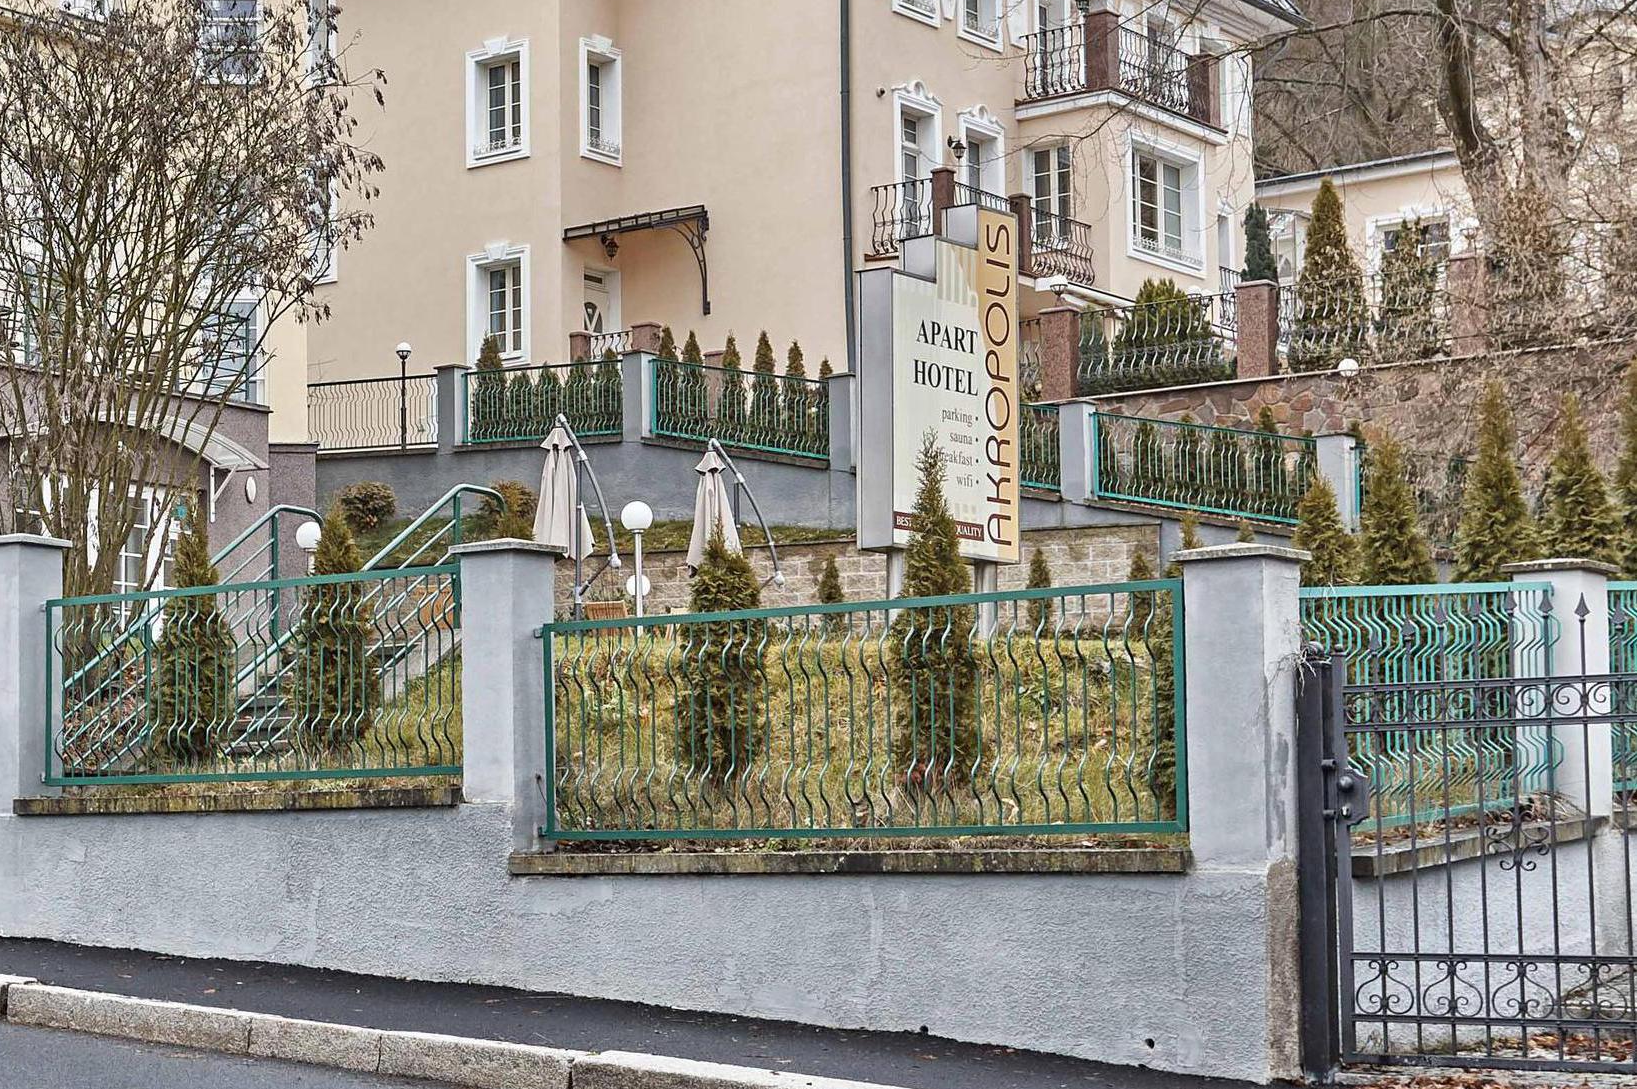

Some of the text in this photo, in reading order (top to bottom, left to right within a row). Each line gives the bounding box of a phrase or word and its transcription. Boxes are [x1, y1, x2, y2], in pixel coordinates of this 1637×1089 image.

[916, 319, 978, 355] APART
[913, 358, 978, 397] HOTEL
[986, 223, 1012, 546] AKROPOLIS
[941, 407, 973, 427] parking
[949, 431, 973, 445] sauna
[937, 448, 973, 466] reakfast
[956, 473, 973, 488] wifi
